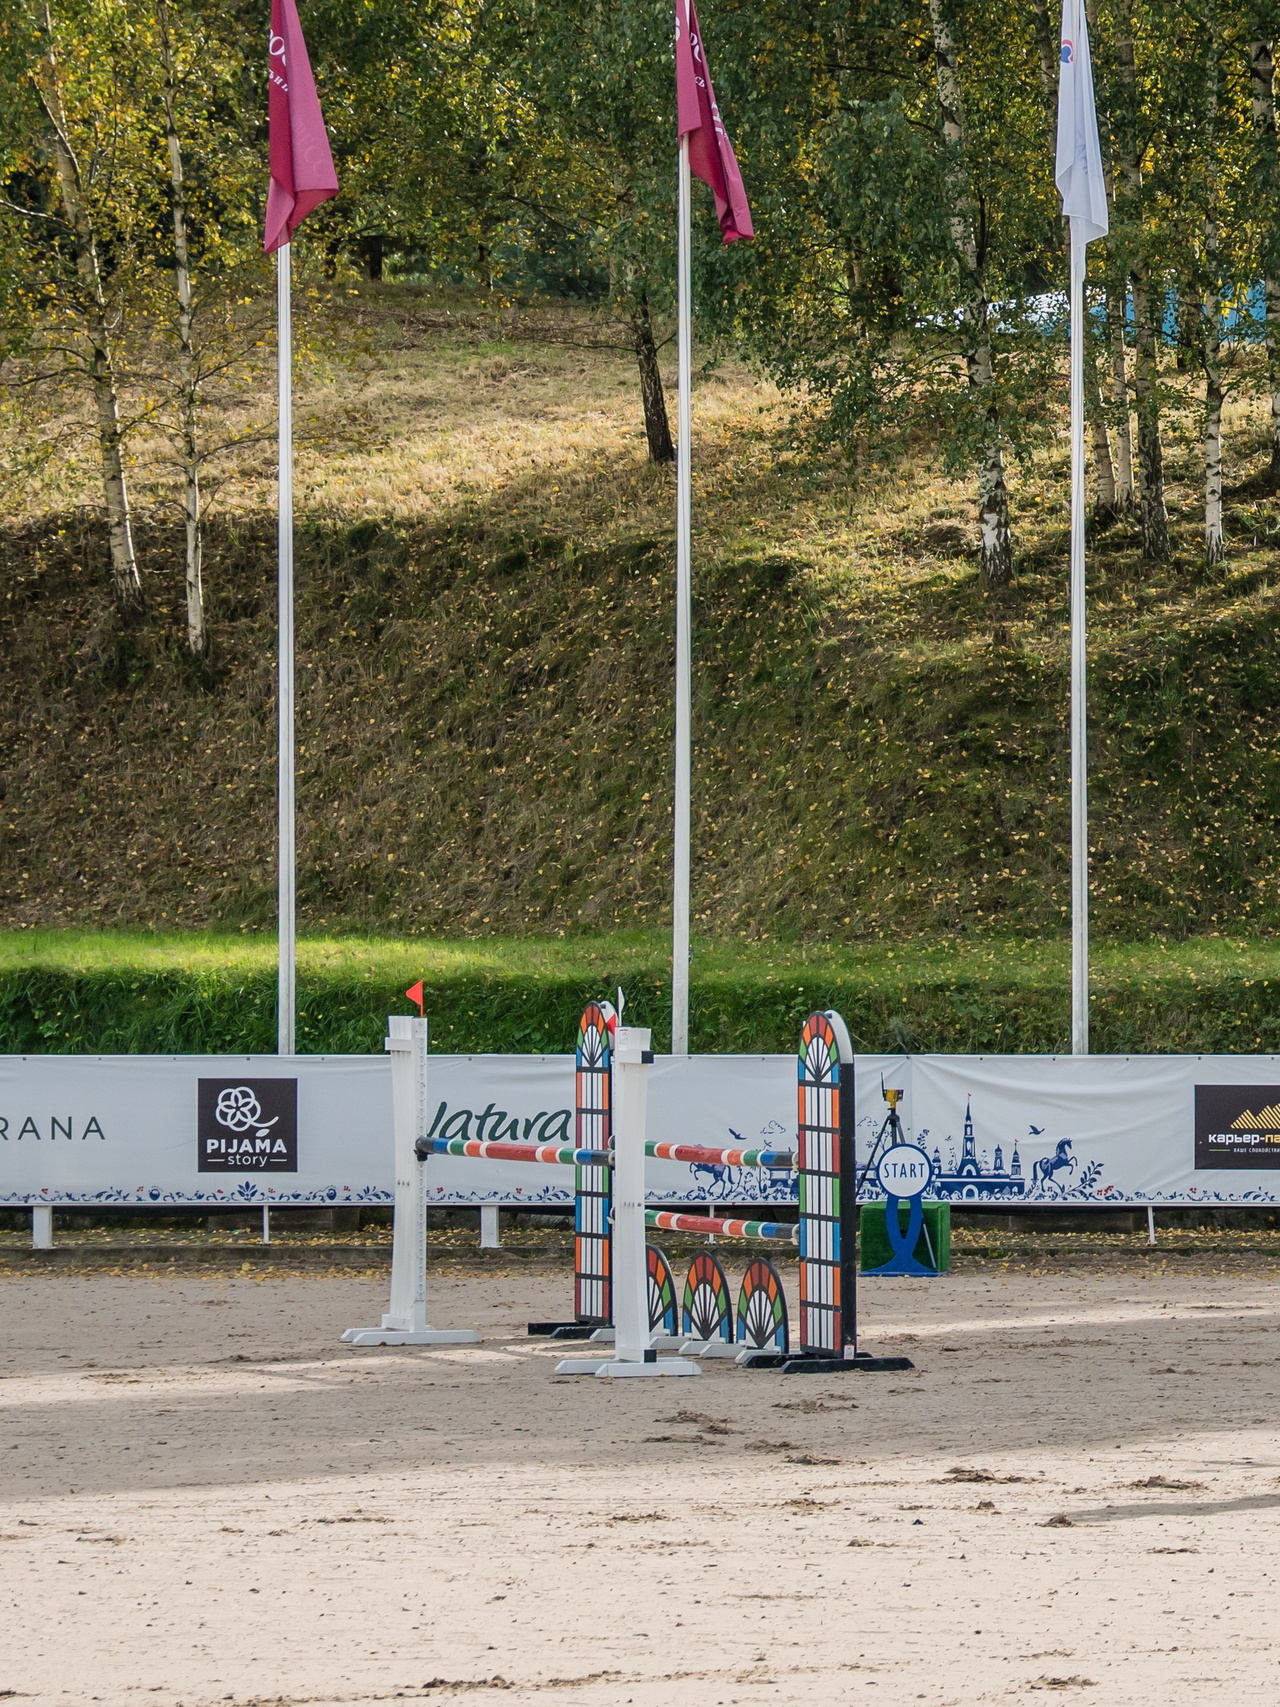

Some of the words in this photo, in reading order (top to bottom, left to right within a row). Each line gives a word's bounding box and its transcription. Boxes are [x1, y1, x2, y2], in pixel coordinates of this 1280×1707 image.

[206, 1138, 287, 1153] PIJAMA
[227, 1152, 268, 1167] story
[883, 1162, 925, 1178] START
